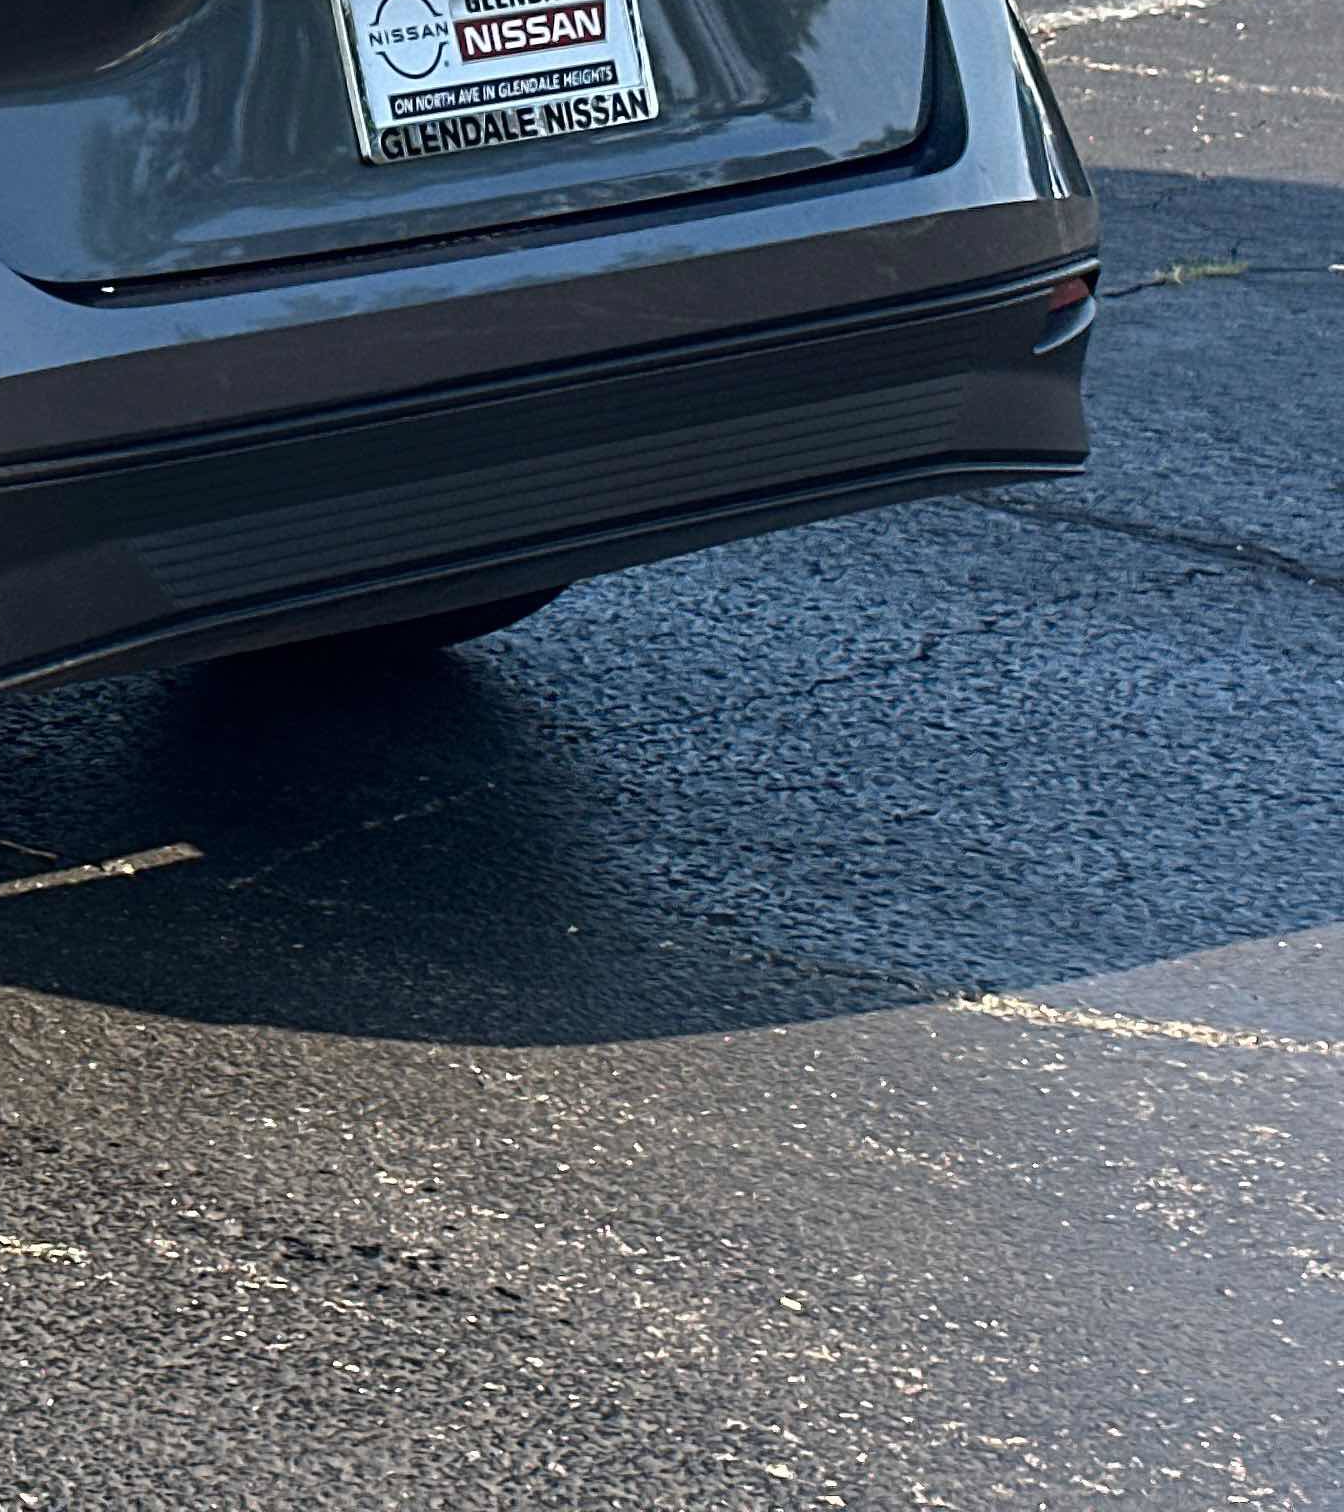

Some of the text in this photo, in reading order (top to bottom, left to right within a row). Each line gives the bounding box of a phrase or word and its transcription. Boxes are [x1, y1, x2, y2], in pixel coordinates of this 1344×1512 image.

[368, 21, 450, 48] NISSAN
[464, 7, 603, 56] NISSAN
[393, 65, 613, 114] ON NORTH AVE IN GLENDALE HEIGHTS
[379, 87, 650, 161] GLENDALE NISSAN
